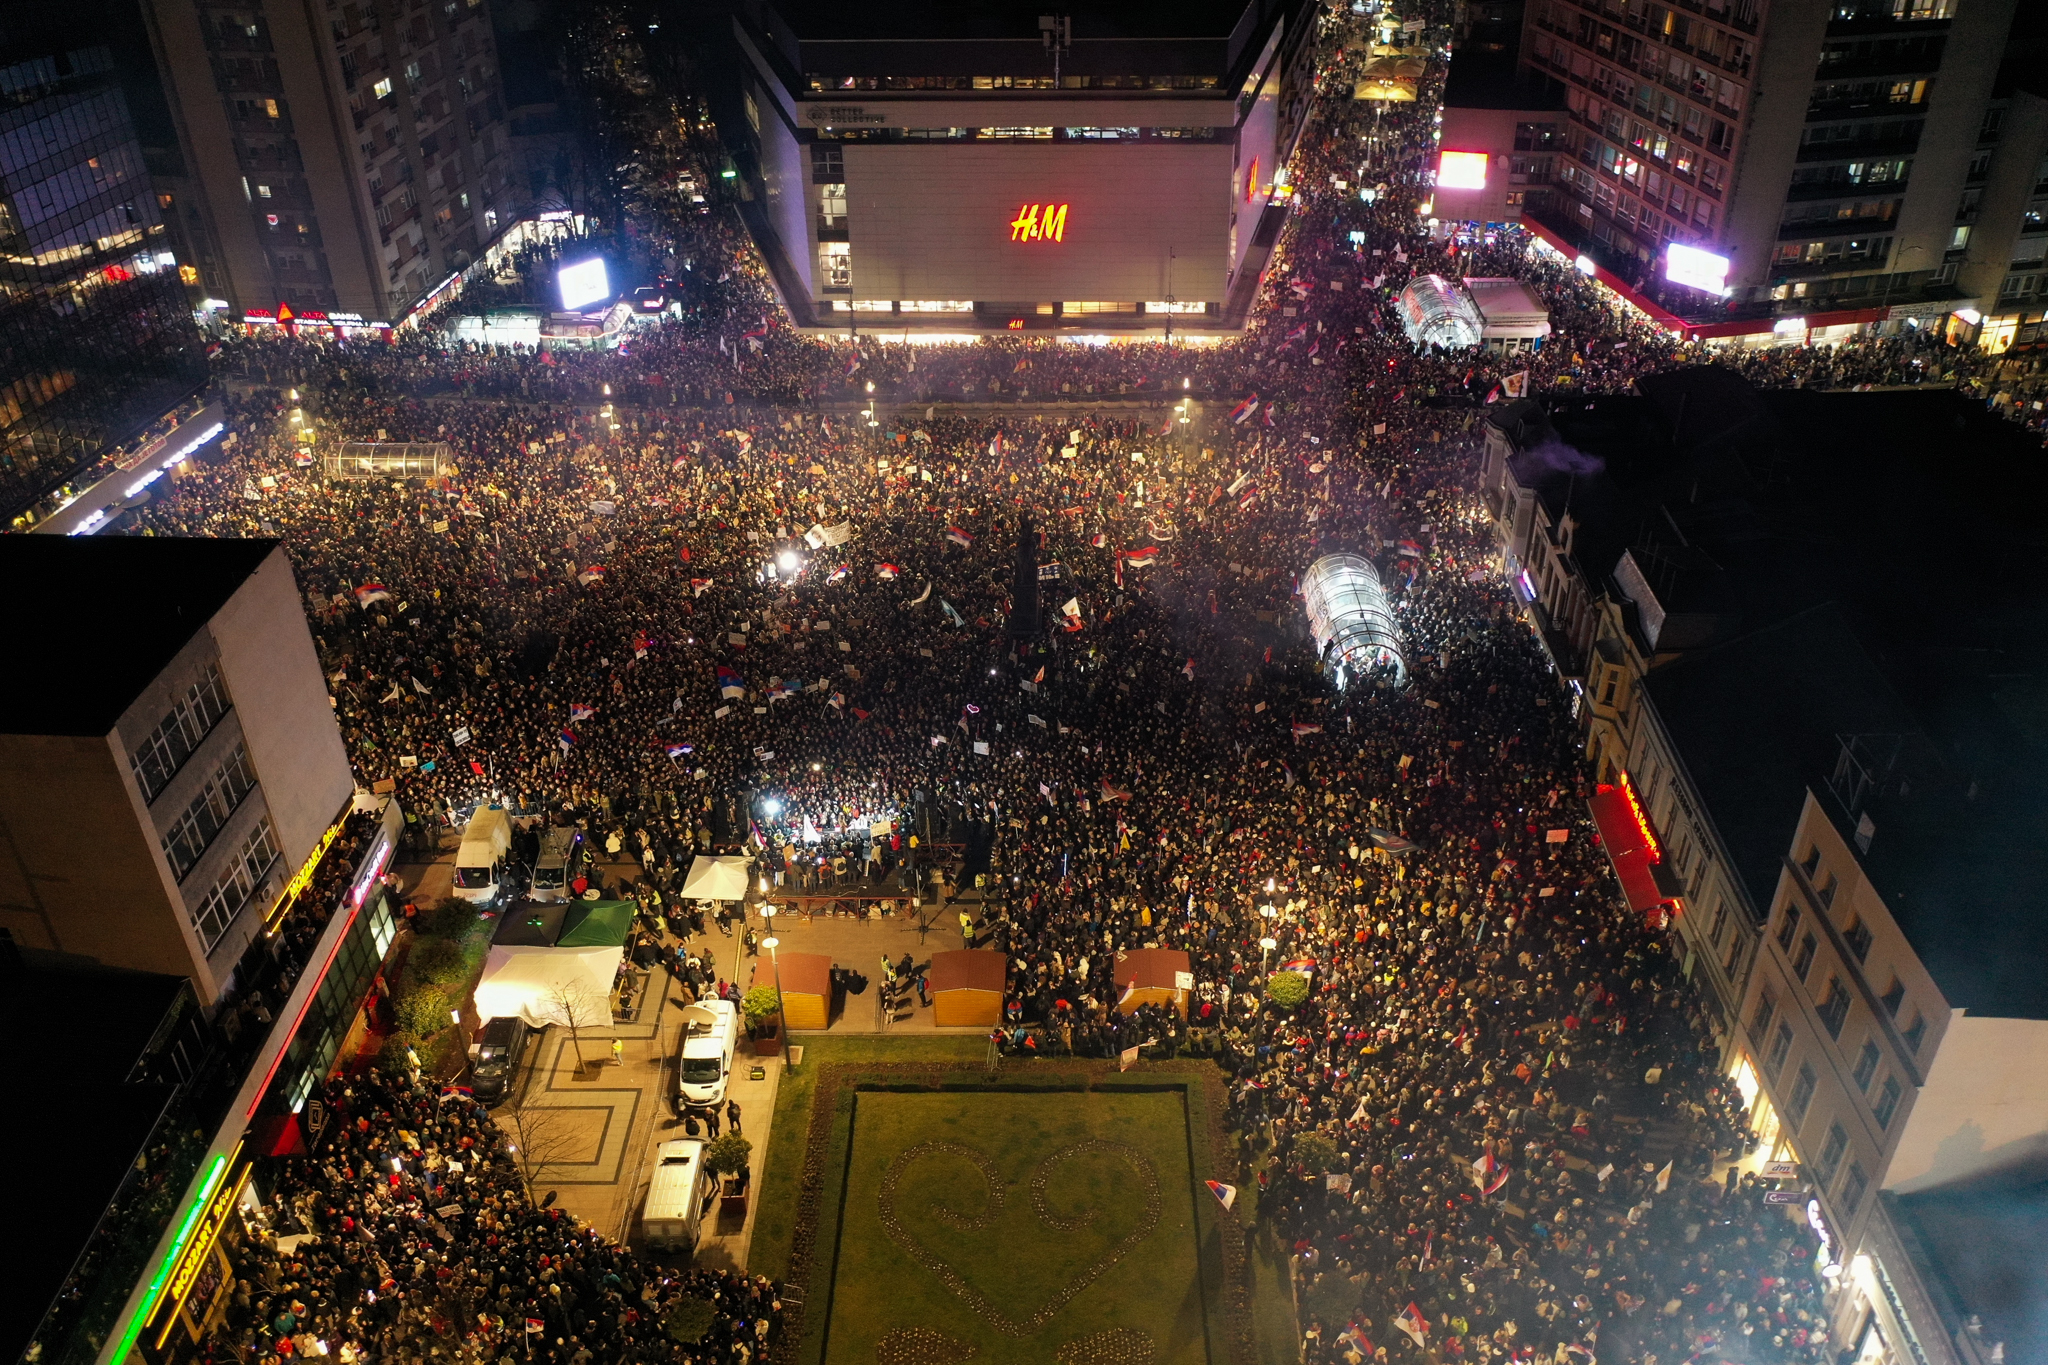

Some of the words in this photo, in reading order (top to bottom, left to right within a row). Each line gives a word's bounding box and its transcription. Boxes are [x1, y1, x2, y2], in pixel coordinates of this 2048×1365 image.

[1010, 204, 1068, 242] H&M
[246, 309, 272, 317] ALTA
[301, 311, 328, 319] ALTA
[1008, 319, 1024, 330] H&M
[289, 843, 321, 899] MOZZART
[1771, 1164, 1791, 1172] dm
[172, 1220, 212, 1300] MOZZART
